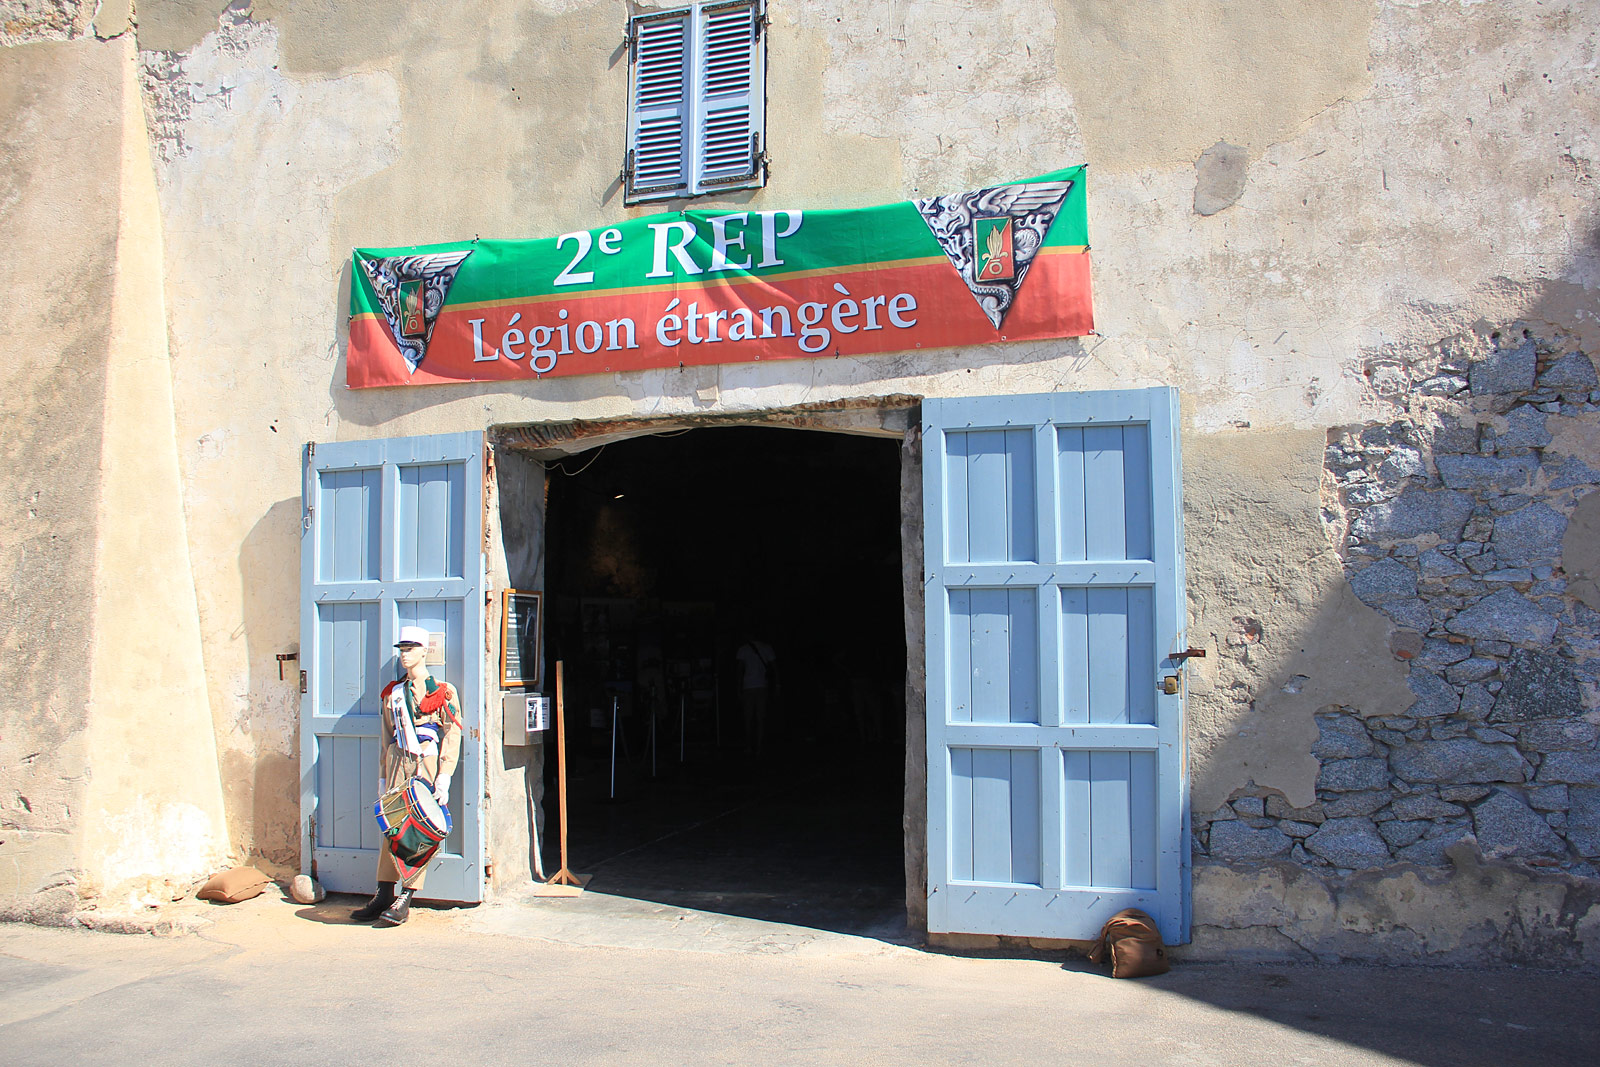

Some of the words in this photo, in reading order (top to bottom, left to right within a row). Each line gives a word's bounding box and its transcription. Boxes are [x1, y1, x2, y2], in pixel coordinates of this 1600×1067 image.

[553, 228, 623, 287] 2e
[645, 210, 803, 278] REP
[468, 308, 639, 373] Légion
[655, 282, 918, 352] étrangère
